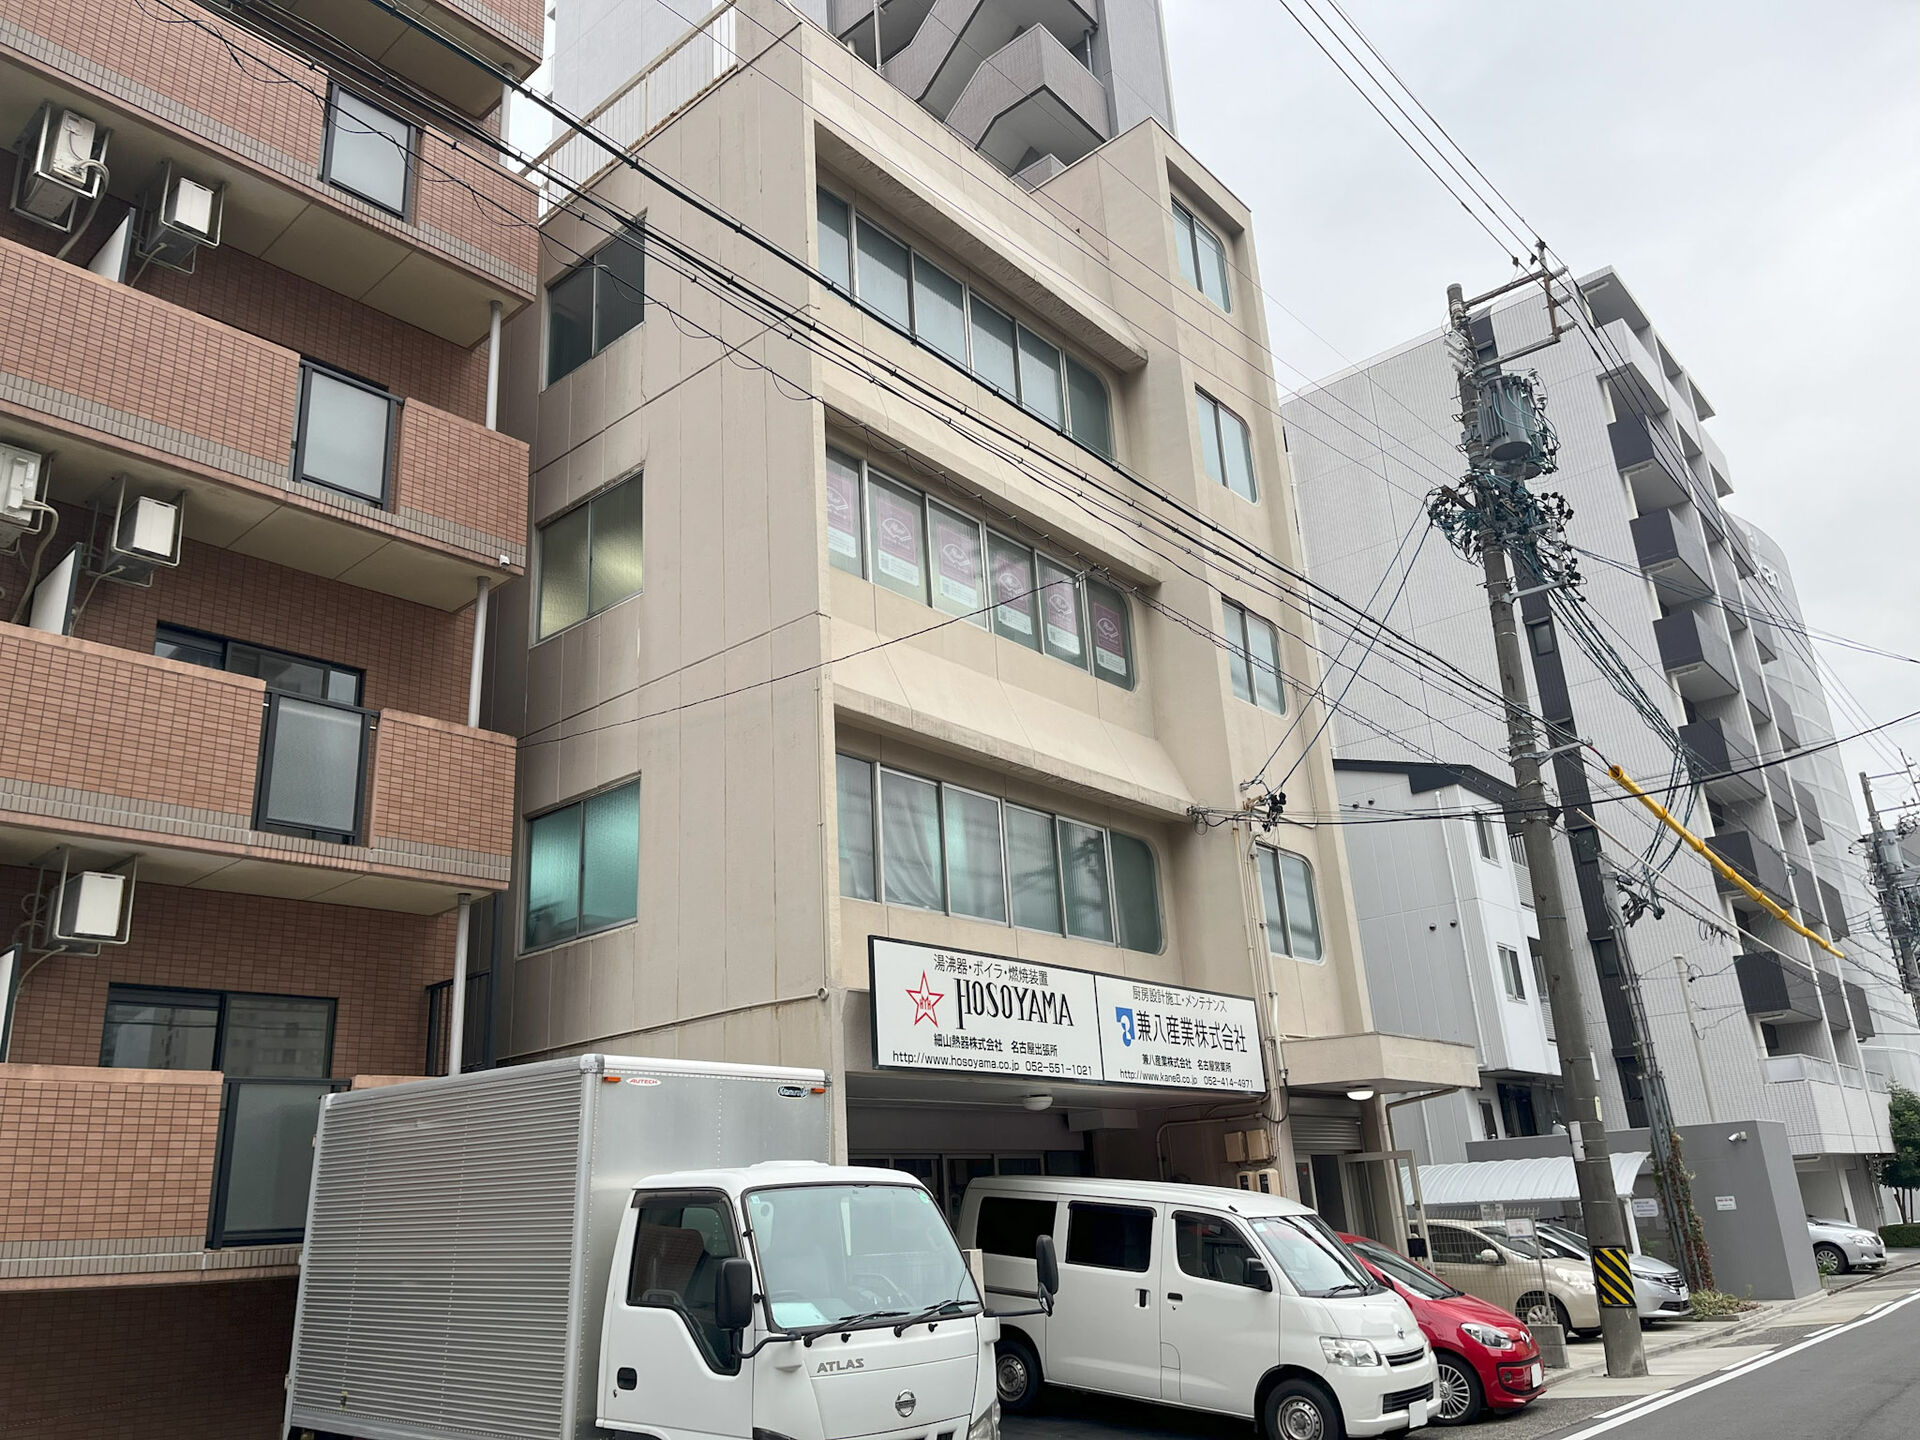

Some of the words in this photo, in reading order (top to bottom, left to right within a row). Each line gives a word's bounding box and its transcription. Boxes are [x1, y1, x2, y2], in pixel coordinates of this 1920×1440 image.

[953, 977, 1075, 1030] HOSOYAMA
[1136, 1010, 1248, 1053] 兼八産業株式会社
[933, 1033, 1003, 1052] 細山熱器株式会社
[1011, 1040, 1059, 1057] 名古屋出張所
[892, 1050, 1020, 1072] http://www.hosoyama.co.jp
[1025, 1060, 1093, 1076] 052-551-1021
[1142, 1054, 1192, 1069] 兼八産業株式会社
[1197, 1059, 1232, 1073] 名古屋営業所
[1120, 1069, 1198, 1085] http://www.kane8.co.jp
[1203, 1075, 1254, 1088] 052-414-4971
[817, 1358, 864, 1373] ATLAS
